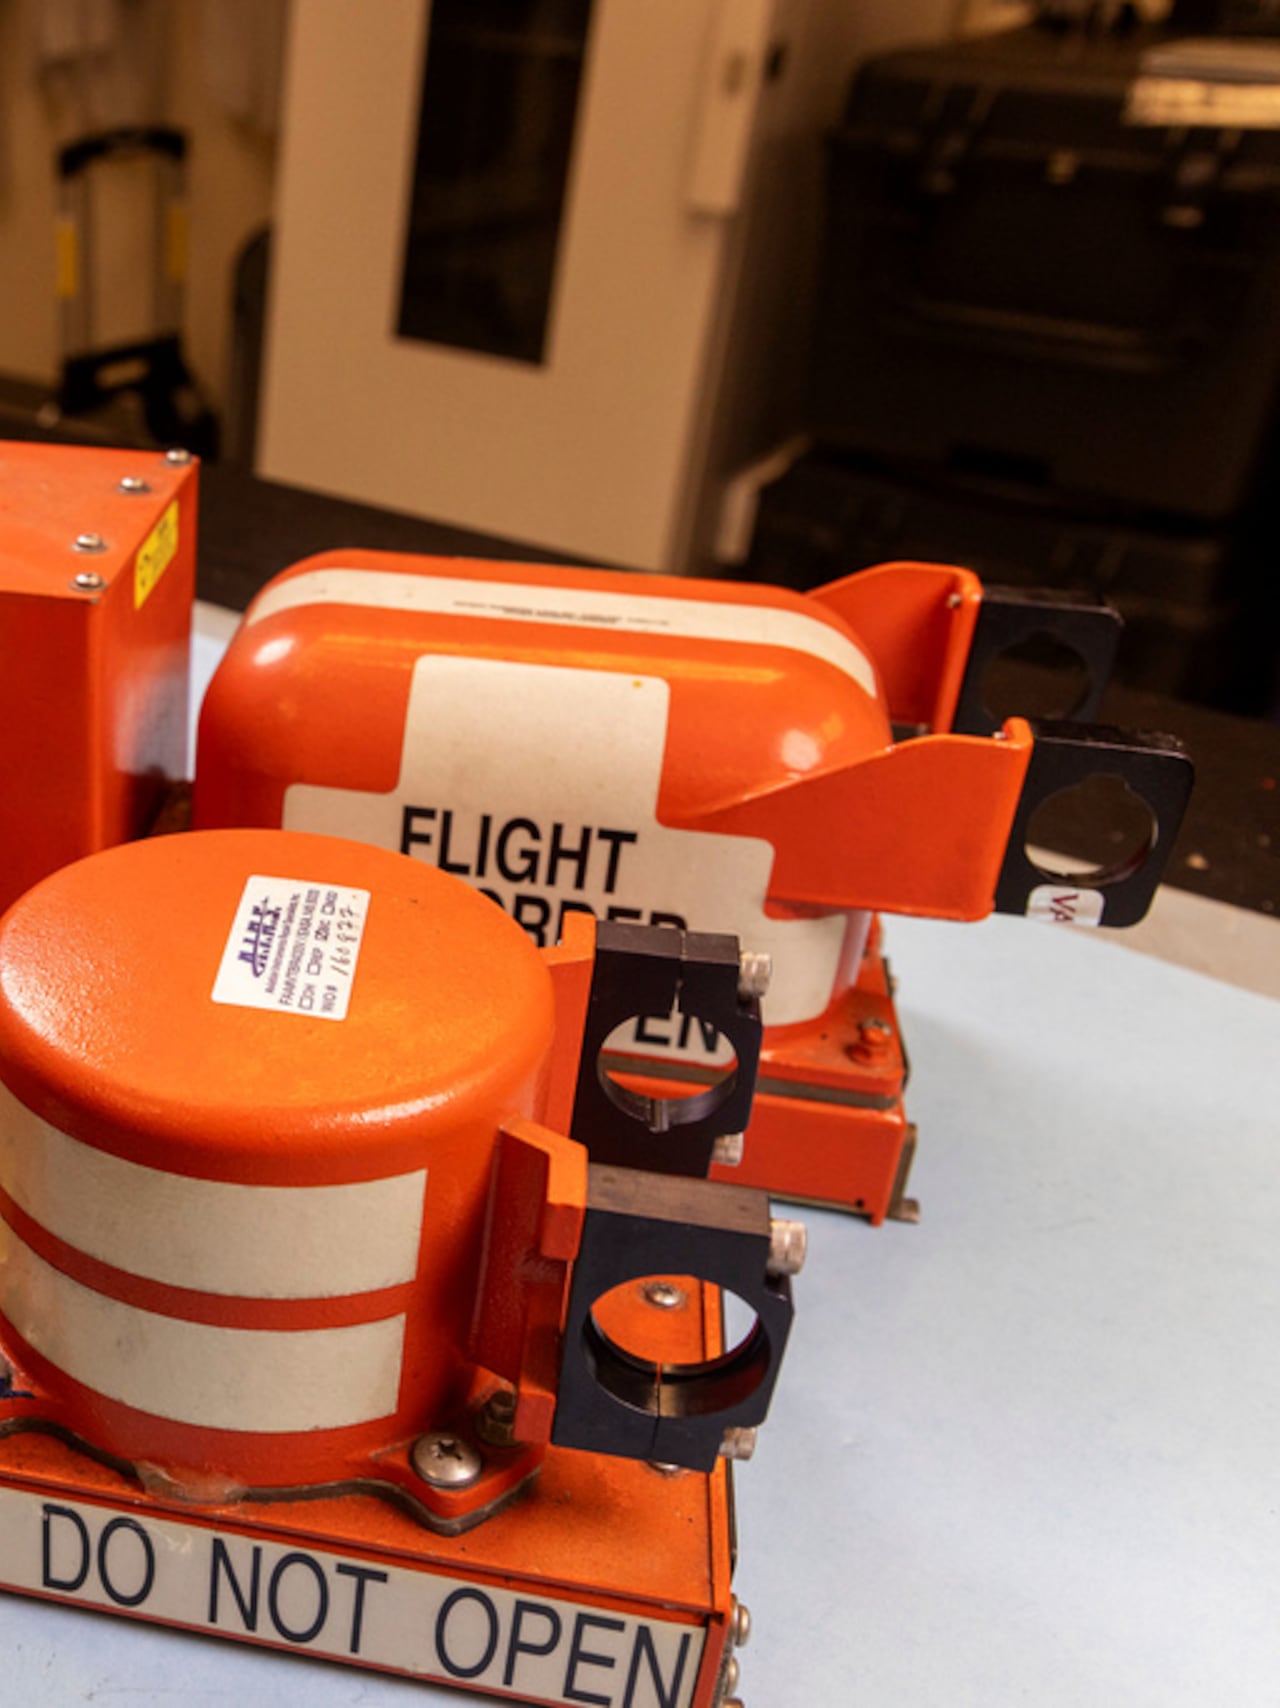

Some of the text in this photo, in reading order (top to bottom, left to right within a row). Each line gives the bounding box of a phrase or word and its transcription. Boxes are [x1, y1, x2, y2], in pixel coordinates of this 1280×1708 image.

[400, 805, 638, 894] FLIGHT
[633, 1011, 722, 1053] EN
[41, 1503, 157, 1609] DO
[209, 1537, 389, 1655] NOT
[434, 1587, 692, 1708] OPEN
